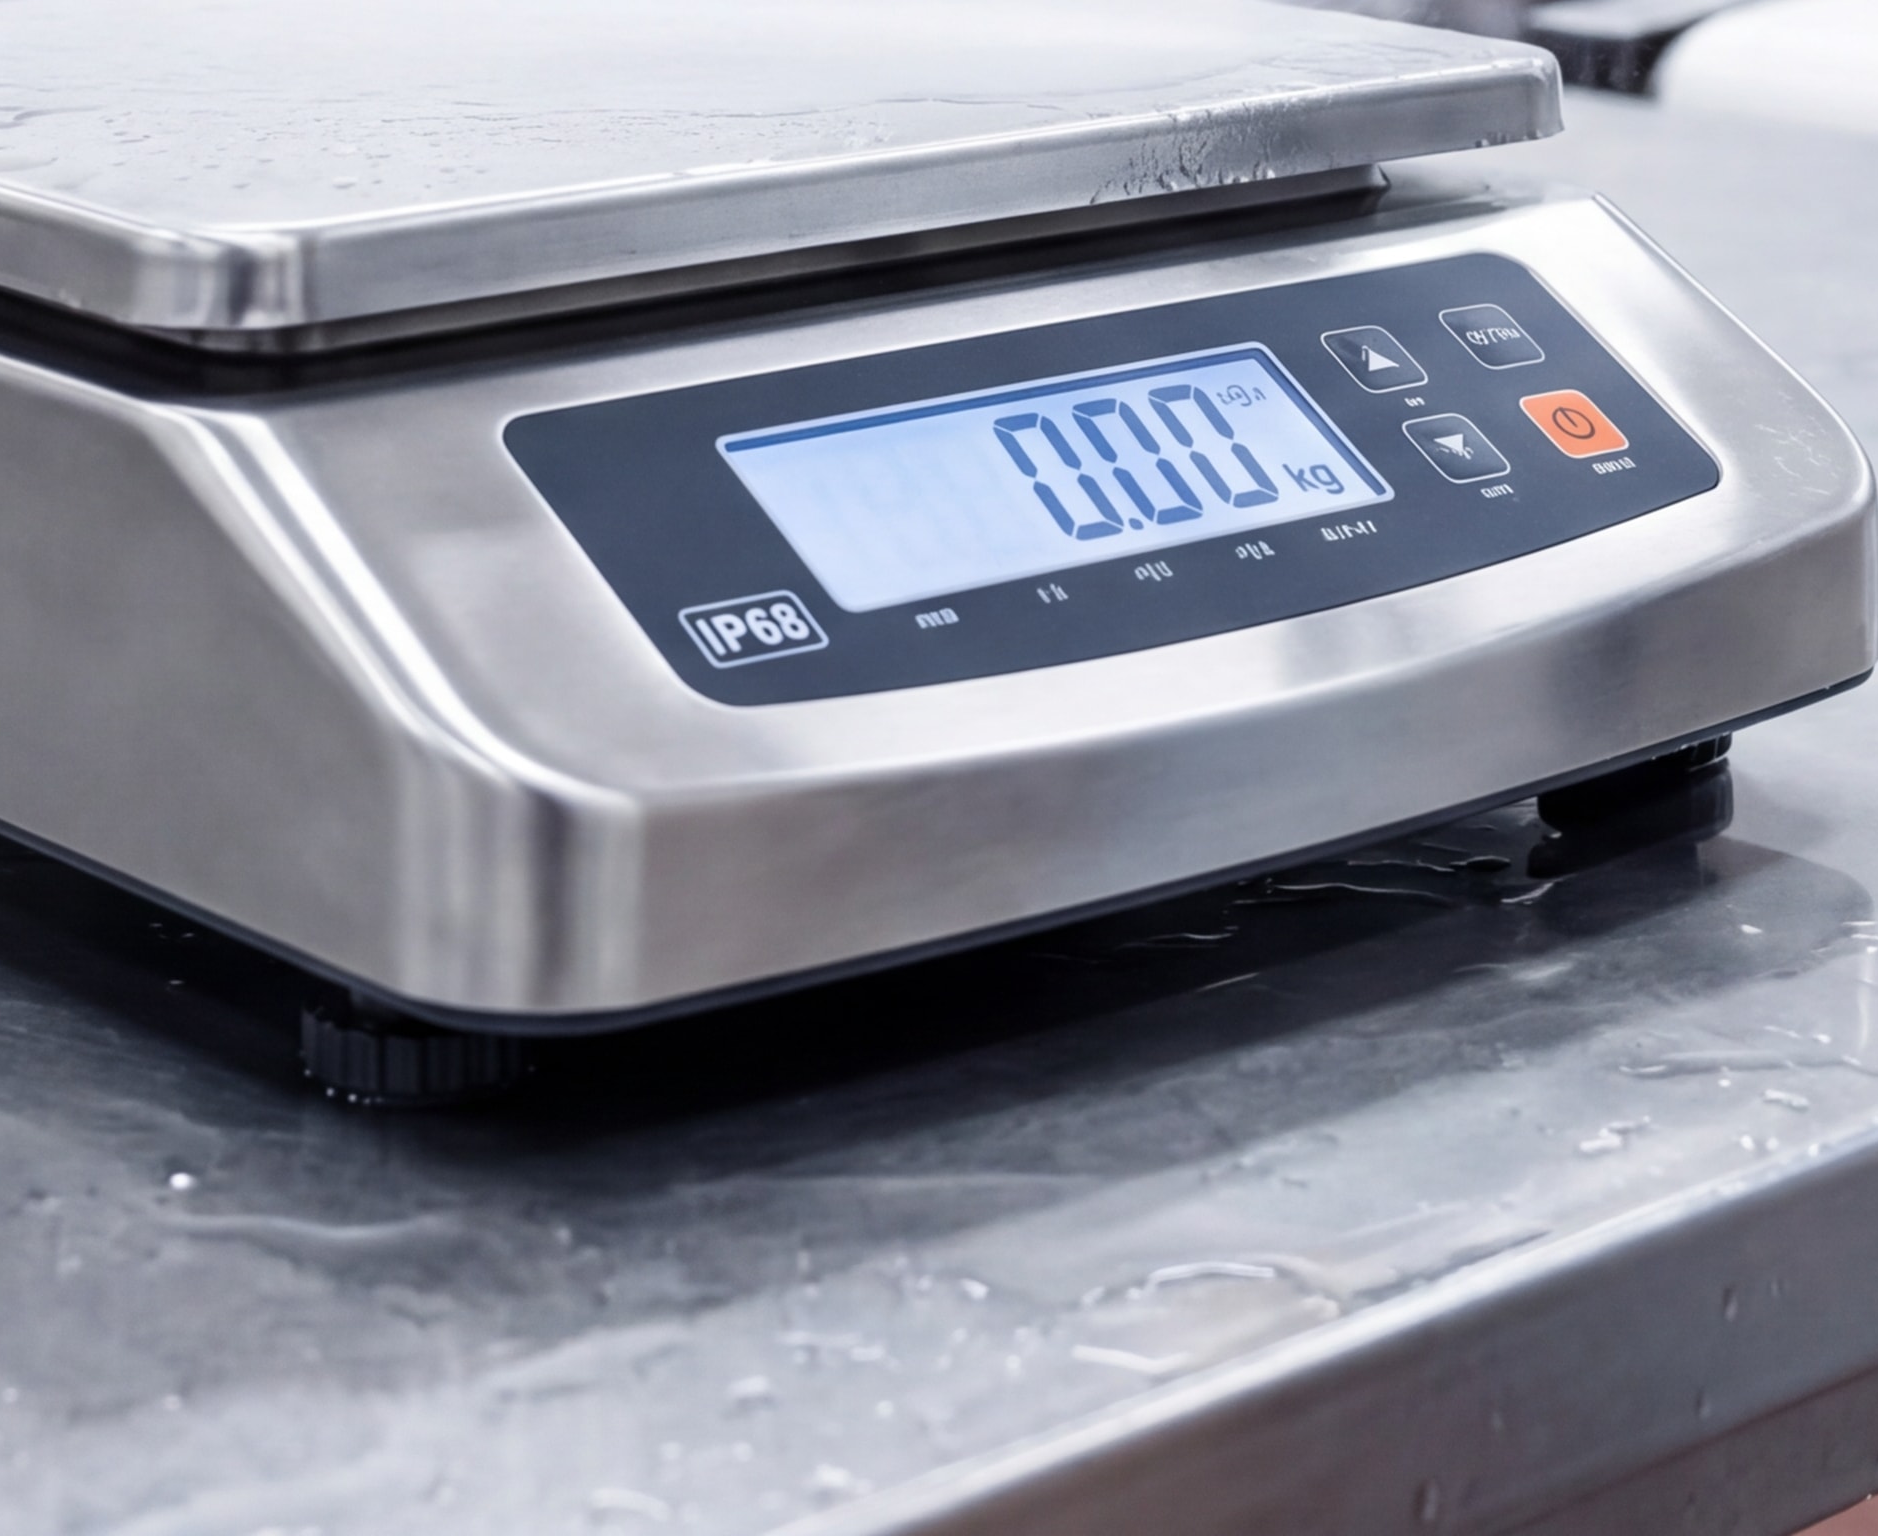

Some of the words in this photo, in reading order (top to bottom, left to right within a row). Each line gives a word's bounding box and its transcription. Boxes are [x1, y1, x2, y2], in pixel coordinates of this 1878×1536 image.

[993, 384, 1279, 541] 0.00
[1282, 463, 1345, 495] kg
[695, 602, 811, 657] IP68
